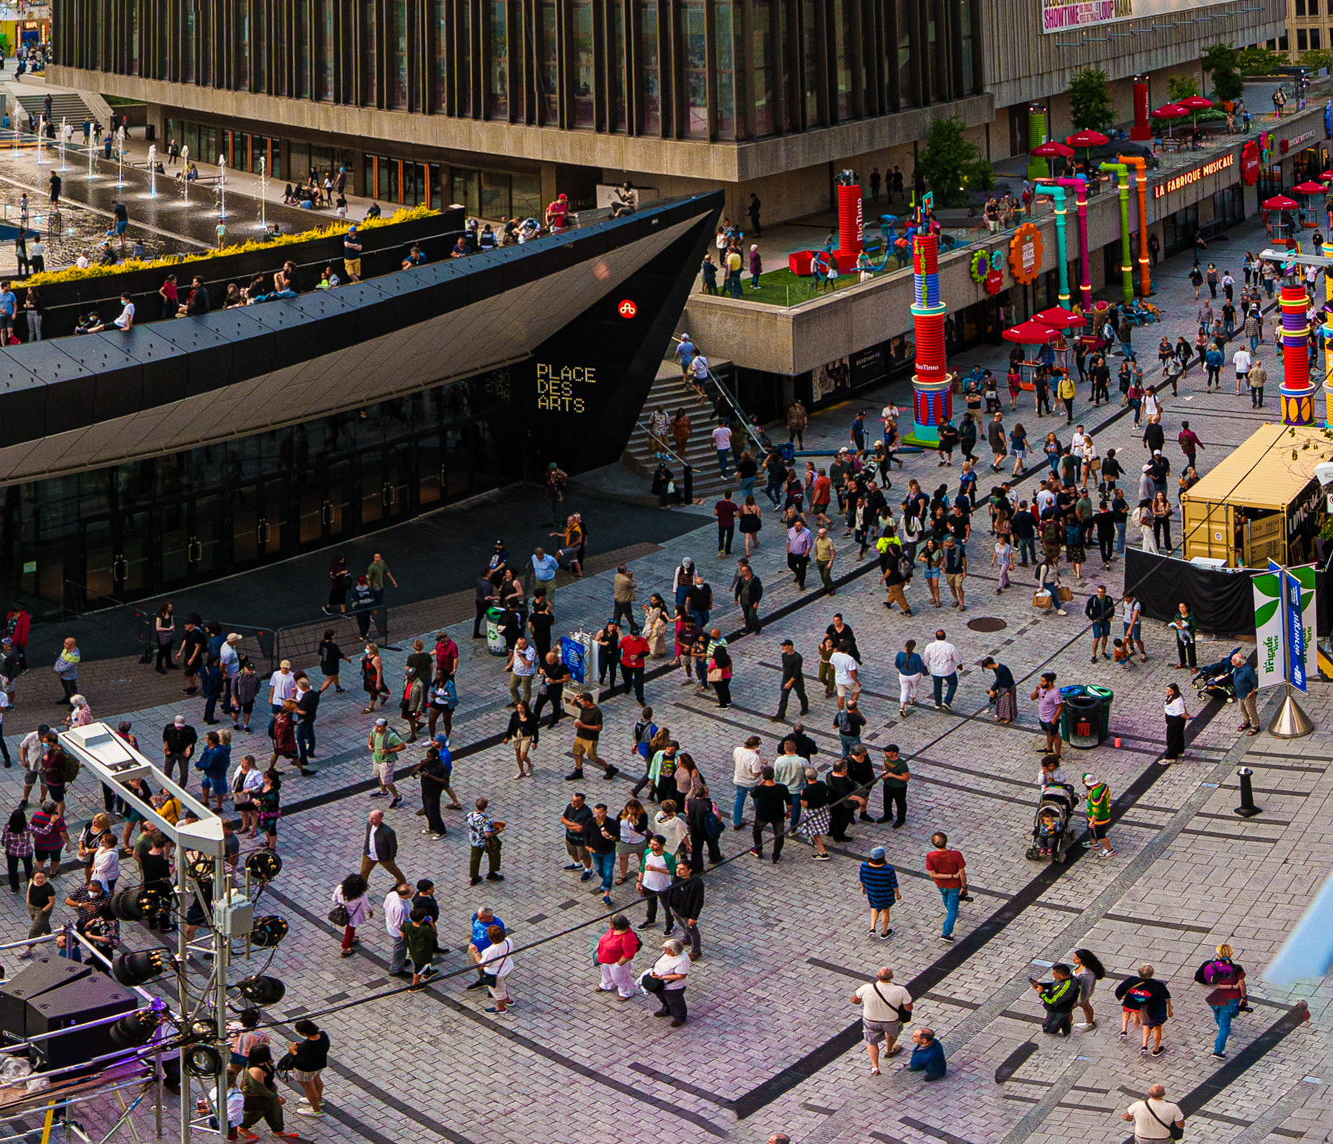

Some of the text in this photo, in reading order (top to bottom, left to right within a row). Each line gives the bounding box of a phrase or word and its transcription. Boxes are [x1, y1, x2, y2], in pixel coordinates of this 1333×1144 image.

[1044, 5, 1080, 30] SHOWTIME
[1099, 0, 1113, 21] LOUP
[1155, 153, 1234, 198] LA FABRIQUE MUSICALE
[537, 363, 596, 383] PLACE
[537, 379, 573, 396] DES
[537, 395, 585, 413] ARTS
[1265, 636, 1275, 674] Brigade
